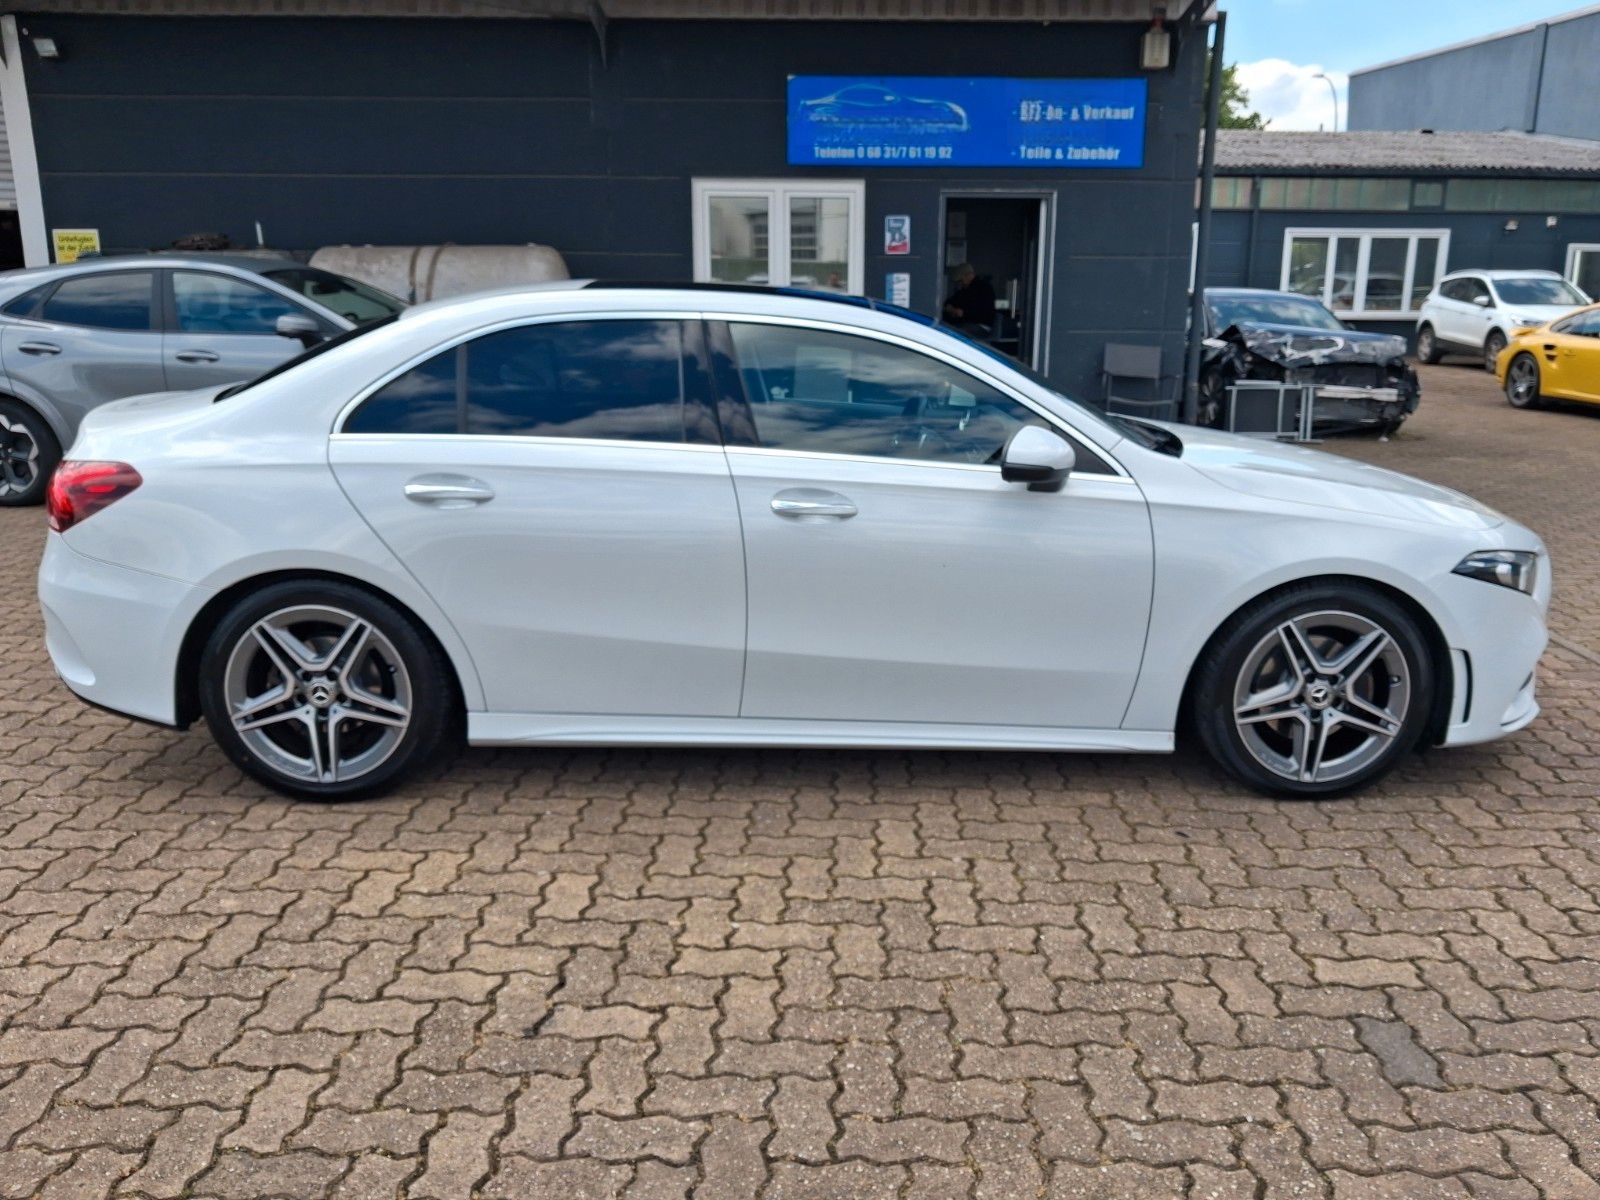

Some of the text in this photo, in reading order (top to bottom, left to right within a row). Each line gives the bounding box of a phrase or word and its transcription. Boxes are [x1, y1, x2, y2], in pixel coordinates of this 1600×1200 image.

[1083, 104, 1135, 120] Verkauf
[814, 145, 855, 158] Telefon
[1020, 145, 1120, 161] Teile & Zubehör
